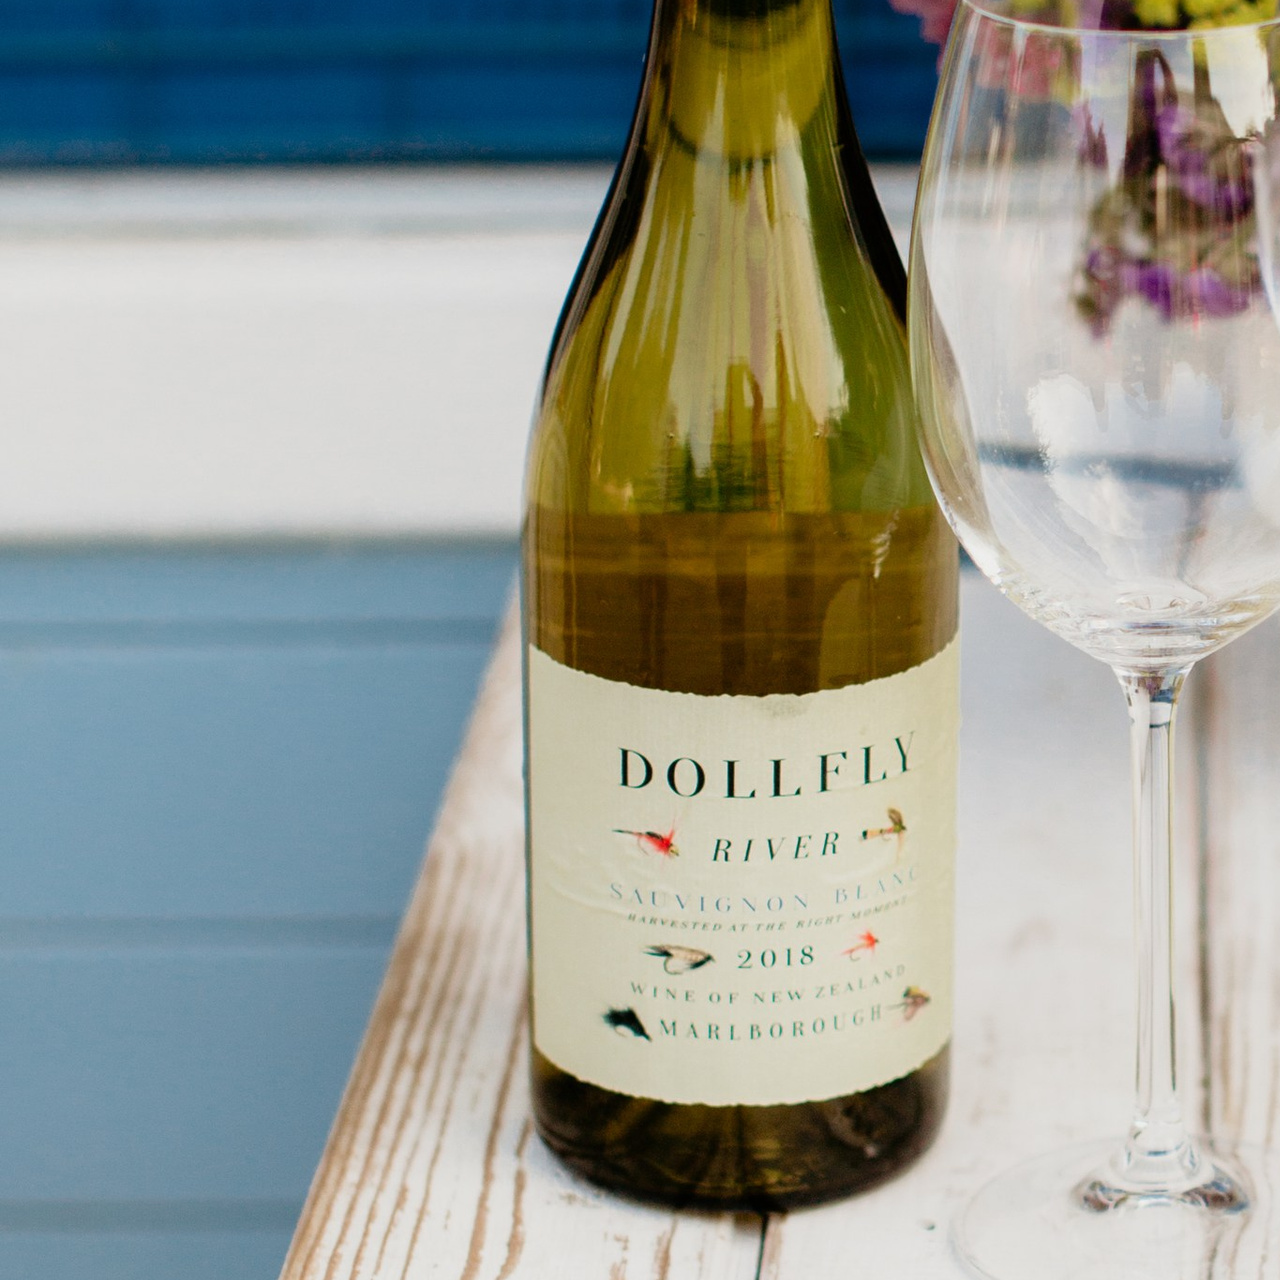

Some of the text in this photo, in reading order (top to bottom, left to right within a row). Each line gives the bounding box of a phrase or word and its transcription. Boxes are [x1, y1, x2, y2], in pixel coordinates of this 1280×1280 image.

[618, 731, 915, 799] DOLLFLY
[712, 831, 840, 862] RIVER
[610, 882, 808, 913] SAUVIGNON
[628, 913, 722, 932] HARVESTED
[728, 923, 749, 932] AT
[755, 922, 787, 932] THE
[796, 913, 843, 929] RIGHT
[737, 945, 815, 969] 2018
[630, 964, 906, 1005] WINE OF NEW ZEALAND
[660, 1003, 882, 1041] MARLBOROUGH
